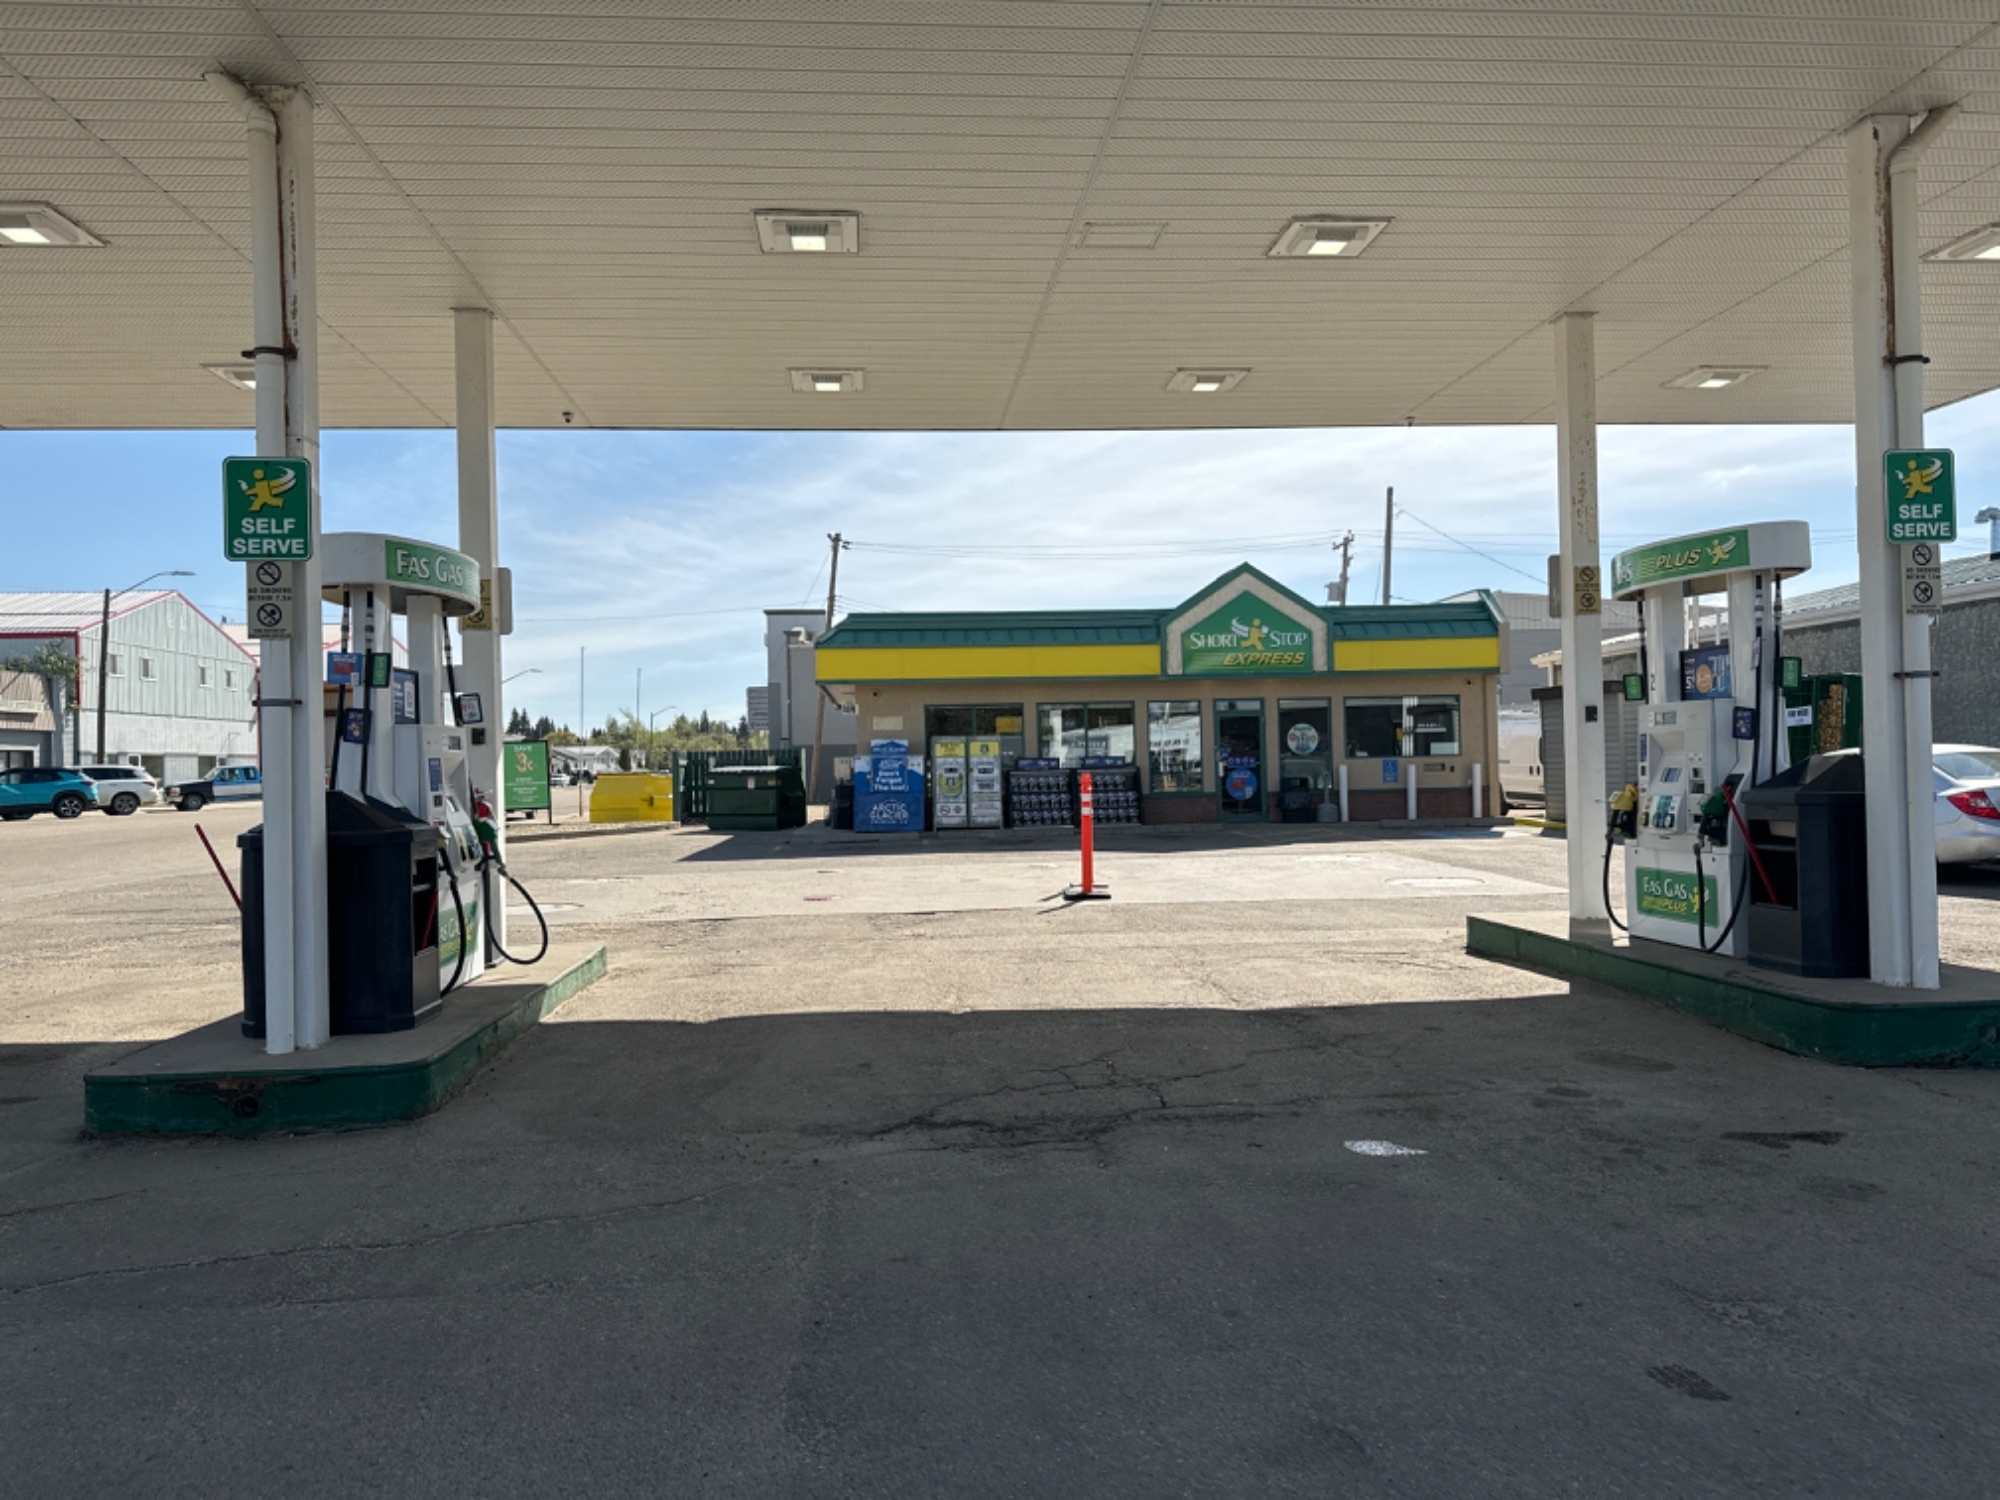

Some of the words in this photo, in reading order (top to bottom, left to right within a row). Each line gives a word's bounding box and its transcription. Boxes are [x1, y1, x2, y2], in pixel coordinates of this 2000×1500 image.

[1898, 503, 1943, 519] SELF
[241, 517, 296, 534] SELF
[1893, 522, 1951, 538] SERVE
[233, 538, 305, 554] SERVE
[1656, 549, 1702, 569] PLUS
[396, 549, 430, 578] FAS
[434, 556, 463, 586] GAS
[1190, 632, 1237, 649] SHORT
[1269, 630, 1308, 648] STOP
[1223, 652, 1305, 667] EXPRESS
[869, 810, 908, 820] GLACIER
[872, 803, 906, 811] ARCTIC
[1643, 877, 1661, 895] FAS
[1664, 878, 1687, 899] GAS
